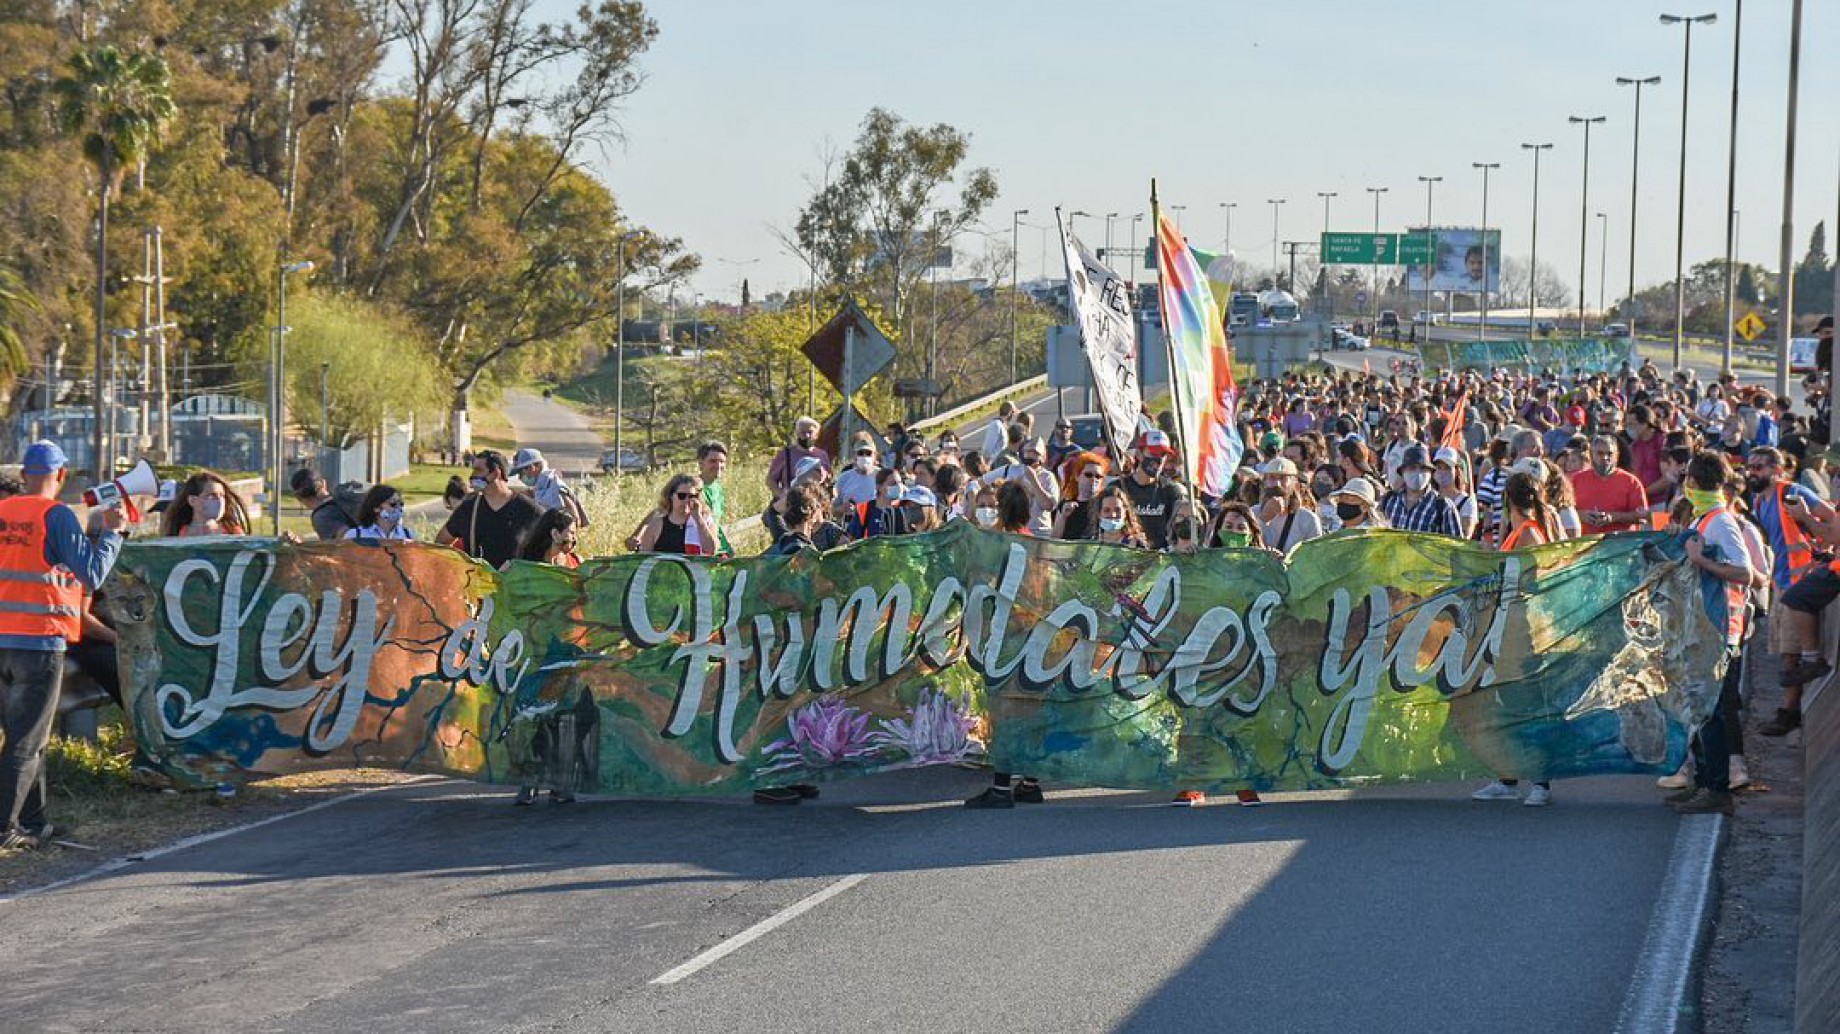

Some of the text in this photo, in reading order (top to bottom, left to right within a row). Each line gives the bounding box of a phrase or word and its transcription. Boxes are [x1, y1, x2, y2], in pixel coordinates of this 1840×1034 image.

[156, 549, 394, 753] Ley
[440, 596, 530, 695] de
[622, 553, 1282, 765] Humedales
